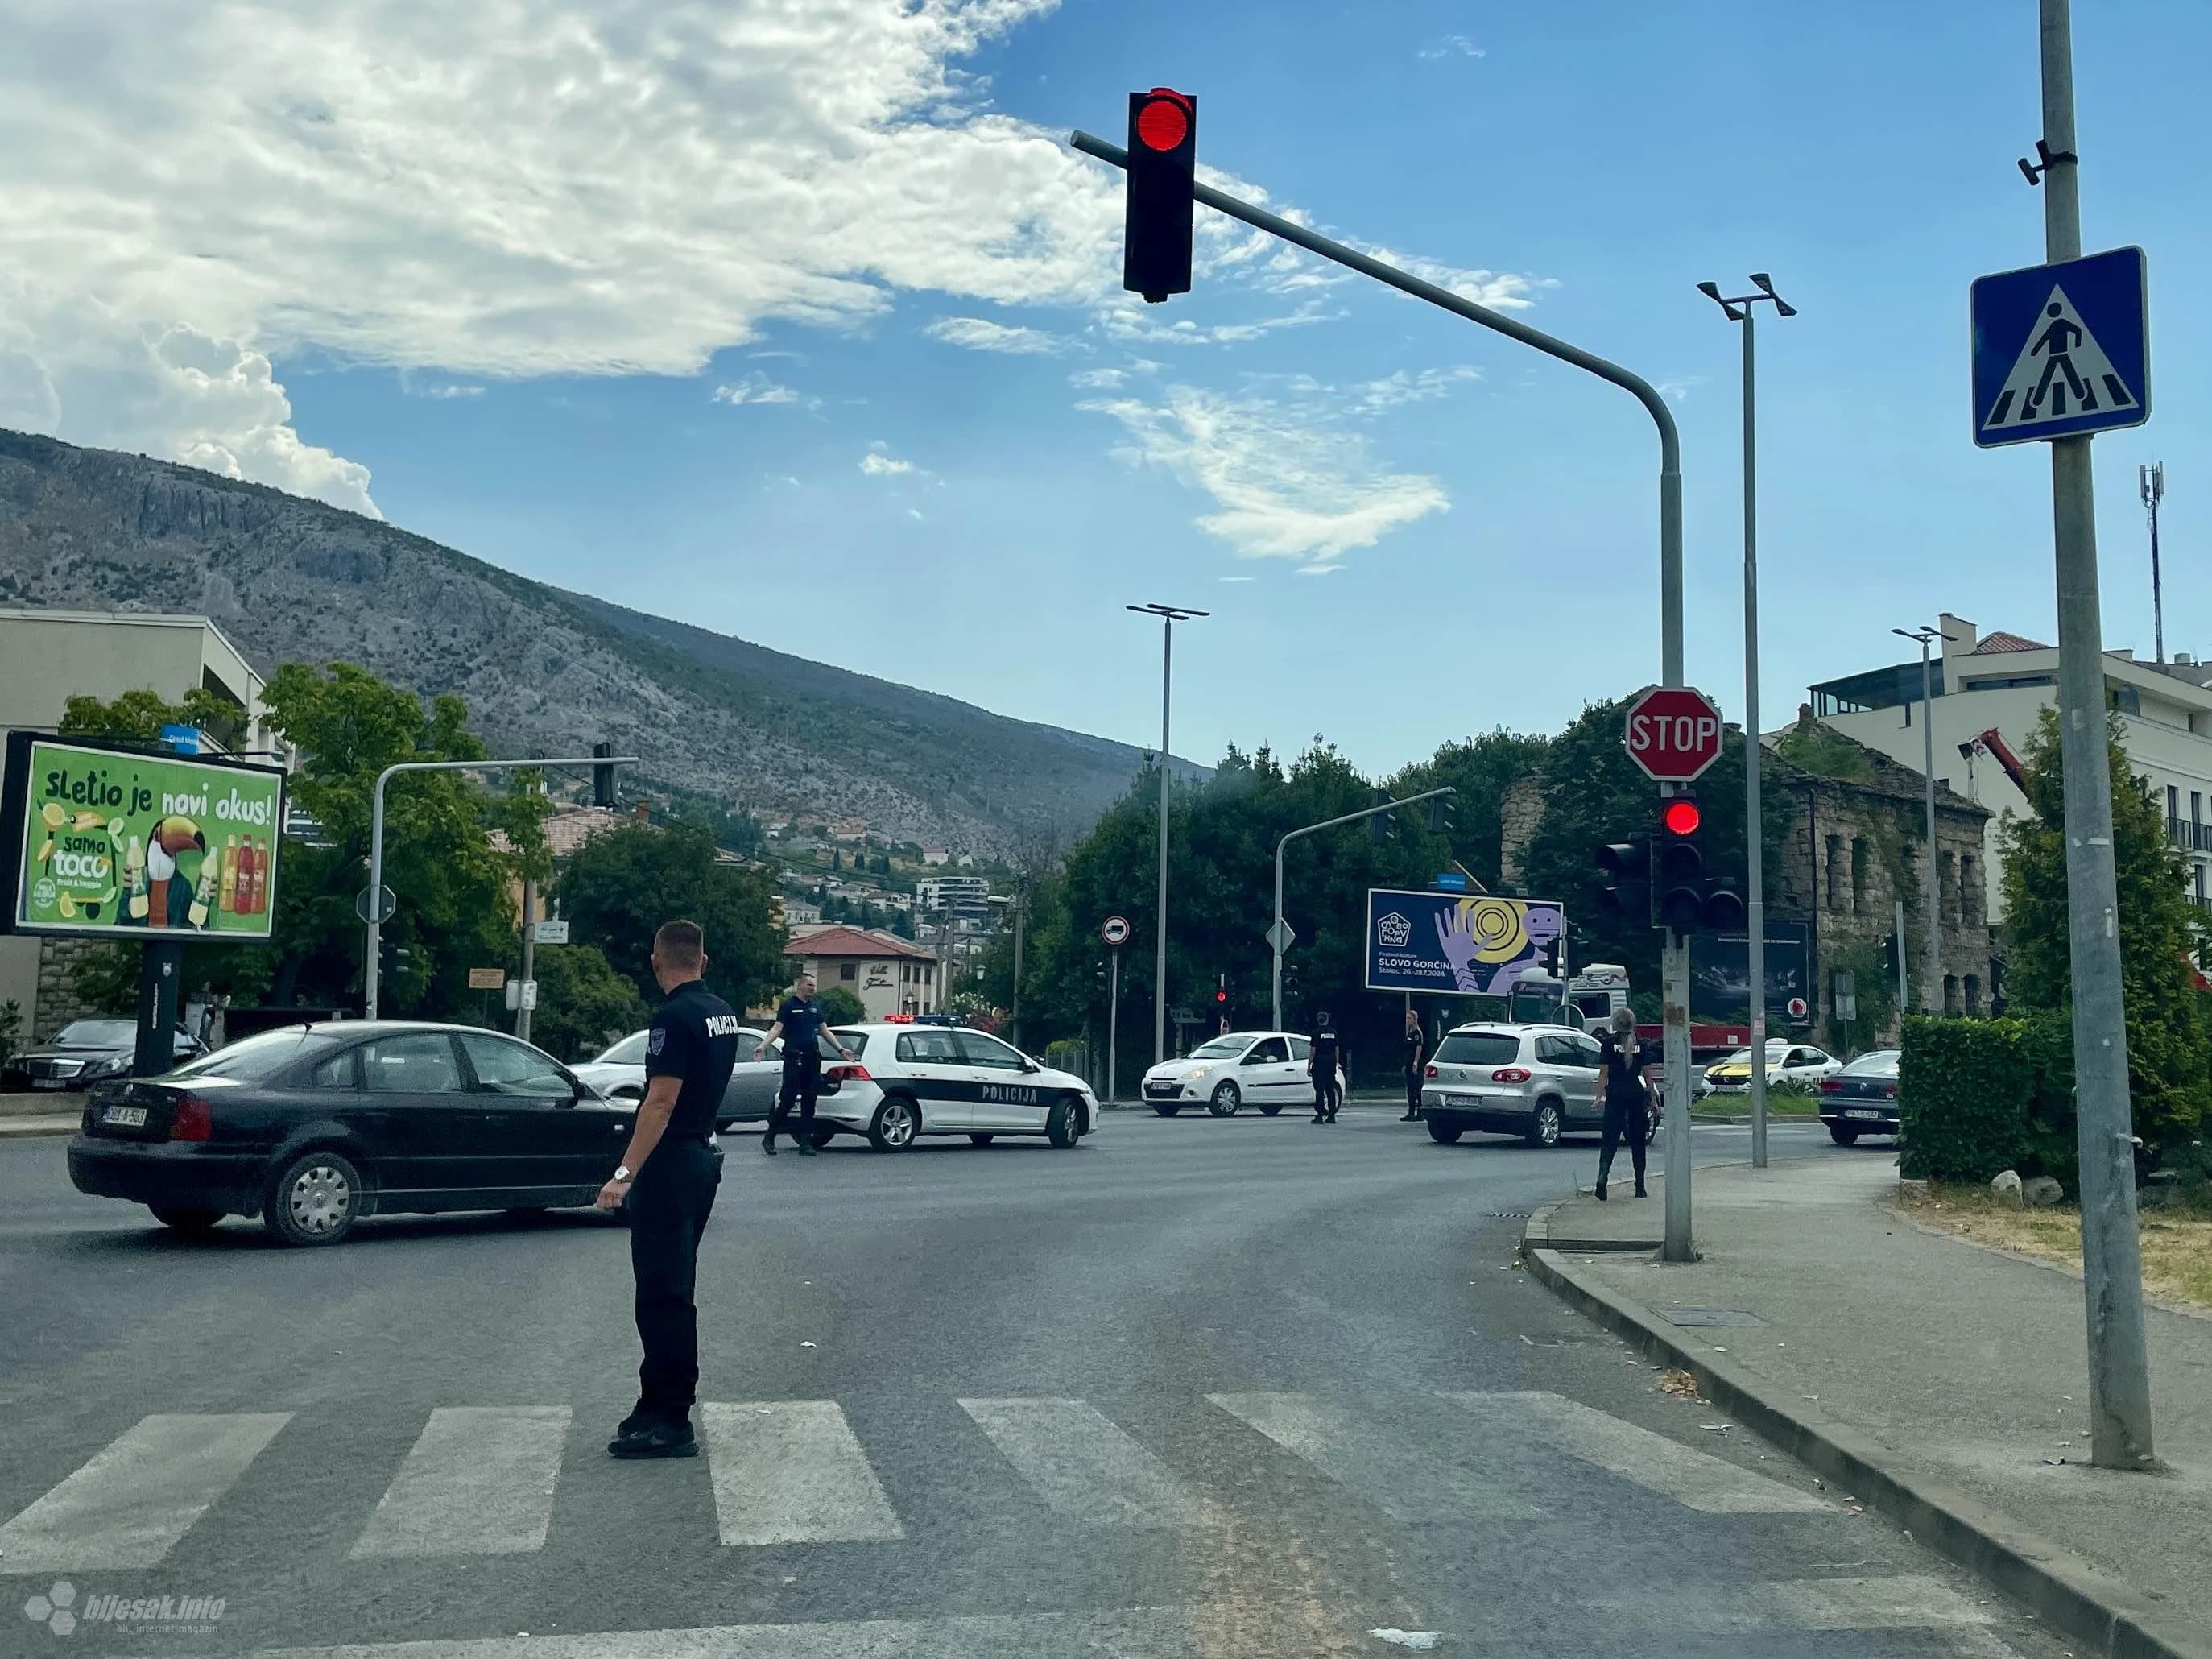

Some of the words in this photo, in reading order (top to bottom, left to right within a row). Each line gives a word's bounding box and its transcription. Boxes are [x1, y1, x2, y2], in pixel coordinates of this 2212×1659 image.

[1631, 714, 1717, 752] STOP
[126, 773, 153, 817] je
[162, 782, 209, 817] novi
[215, 788, 272, 825] okus!
[64, 835, 105, 854] samo
[53, 849, 109, 879] toco
[1379, 958, 1412, 967] SLOVO
[982, 1085, 1037, 1103] POLICIJA
